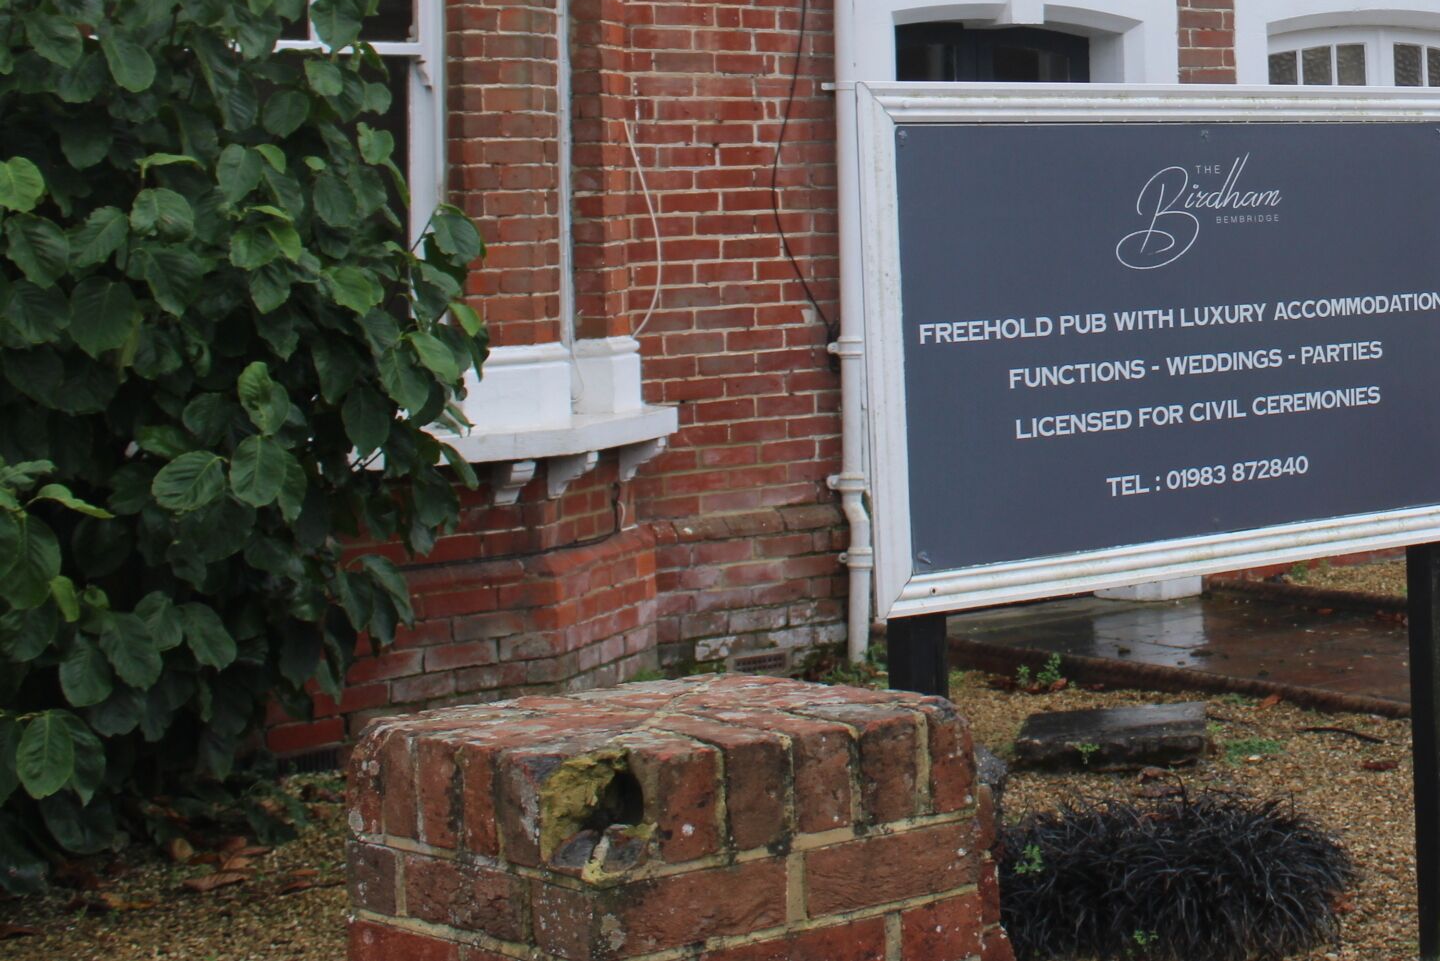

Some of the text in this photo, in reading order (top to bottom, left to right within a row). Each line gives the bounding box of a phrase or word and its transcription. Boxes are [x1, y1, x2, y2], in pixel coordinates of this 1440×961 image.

[1195, 164, 1222, 175] THE
[1115, 151, 1283, 270] Birdham
[1215, 213, 1280, 224] BEMBRIDGE
[918, 316, 1054, 345] FREEHOLD
[1059, 312, 1108, 336] PUB
[1112, 308, 1175, 332] WITH
[1179, 302, 1268, 328] LUXURY
[1008, 359, 1146, 390] FUNCTIONS
[1165, 348, 1284, 377] WEDDINGS
[1300, 340, 1384, 366] PARTIES
[1015, 385, 1382, 440] LICENSED FOR CIVIL CEREMONIES
[1105, 474, 1150, 497] TEL
[1165, 464, 1227, 490] 01983
[1231, 455, 1309, 483] 872840
